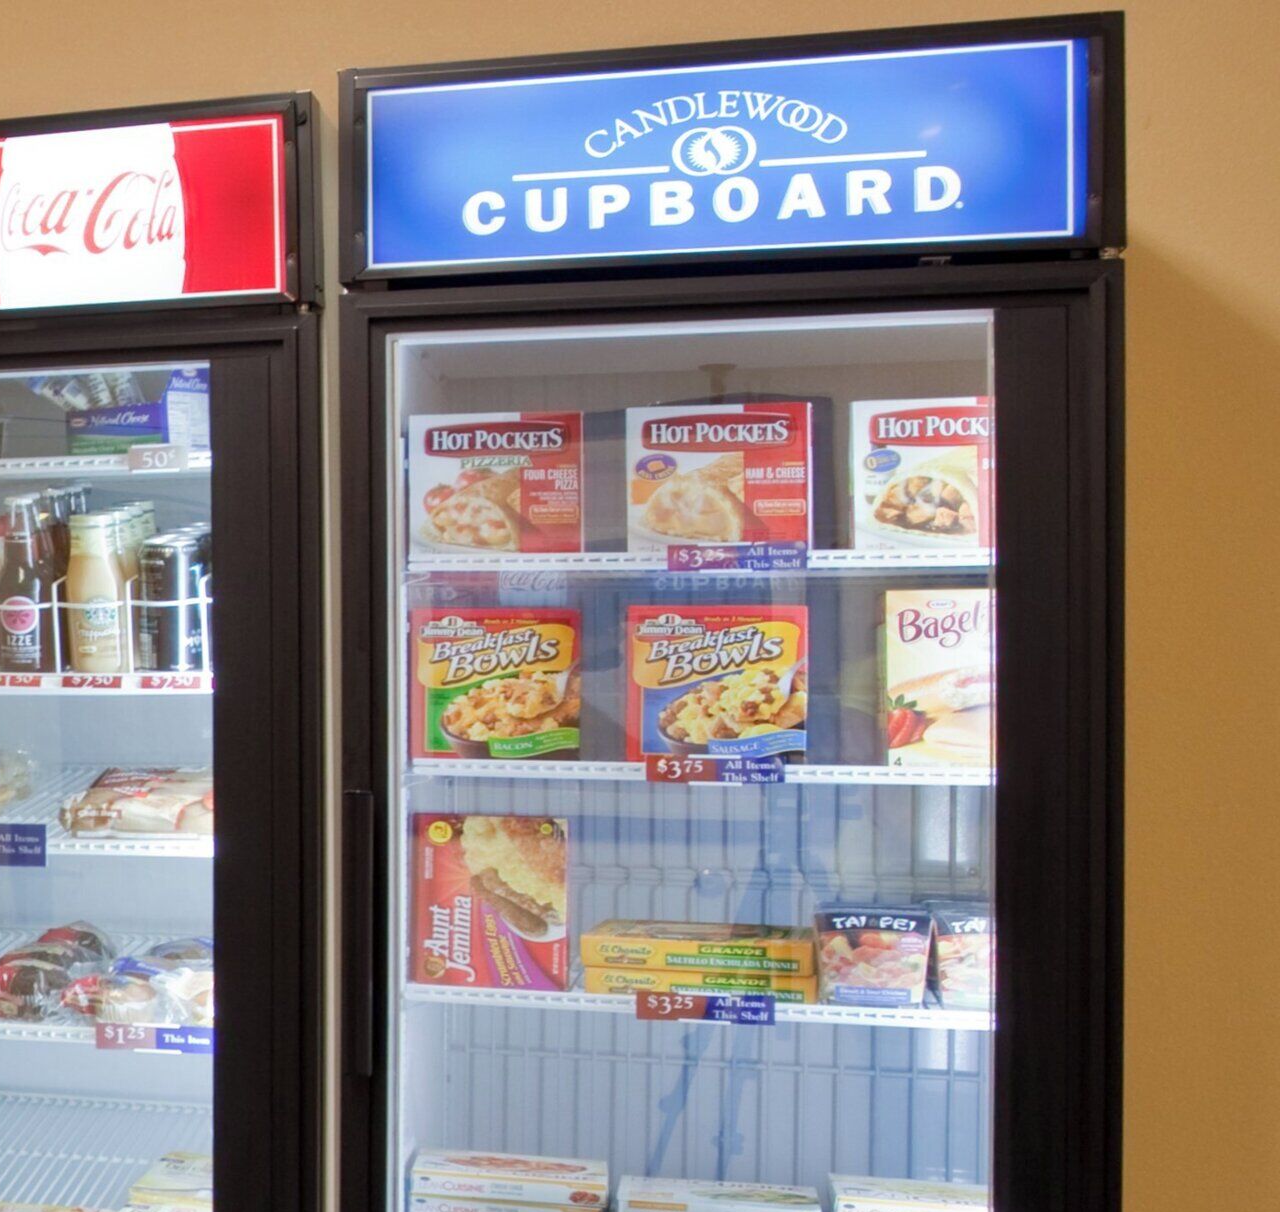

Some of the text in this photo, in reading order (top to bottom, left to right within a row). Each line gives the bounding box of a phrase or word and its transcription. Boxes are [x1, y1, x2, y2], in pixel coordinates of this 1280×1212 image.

[584, 90, 849, 158] CANDLEWOOD
[462, 166, 963, 236] CUPBOARD
[650, 420, 789, 444] HOT POCKETS
[878, 415, 989, 438] HOT POCK
[432, 428, 563, 451] HOT POCKETS
[142, 450, 176, 469] 50¢
[461, 456, 532, 468] PIZZERIA
[524, 469, 578, 480] FOUR CHEESE
[746, 466, 806, 479] HAM & CHEESE
[555, 480, 578, 490] PIZZA
[747, 547, 798, 556] All Items
[745, 558, 801, 568] This Shelf
[898, 600, 981, 648] Bagel
[458, 628, 484, 637] Dean
[639, 625, 704, 635] Jimmy Dean
[7, 634, 33, 646] IZZE
[431, 628, 535, 663] Breakfast
[648, 627, 756, 662] Breakfast
[493, 740, 533, 750] BACON
[712, 742, 760, 753] SAUSAGE
[726, 761, 776, 770] All Items
[894, 756, 903, 767] 4
[723, 773, 778, 782] This Shelf
[14, 834, 40, 843] Items
[18, 845, 42, 854] Shelf
[832, 916, 917, 932] TAI PEI
[951, 918, 987, 933] TAI
[424, 905, 451, 957] Aunt
[447, 896, 476, 983] Jemima
[701, 946, 764, 955] GRANDE
[667, 955, 799, 970] SALTILLO ENCHILADA DINNER
[705, 977, 770, 986] GRANDE
[716, 998, 766, 1008] All Items
[713, 1010, 768, 1021] This Shelf
[163, 1034, 211, 1045] This Item
